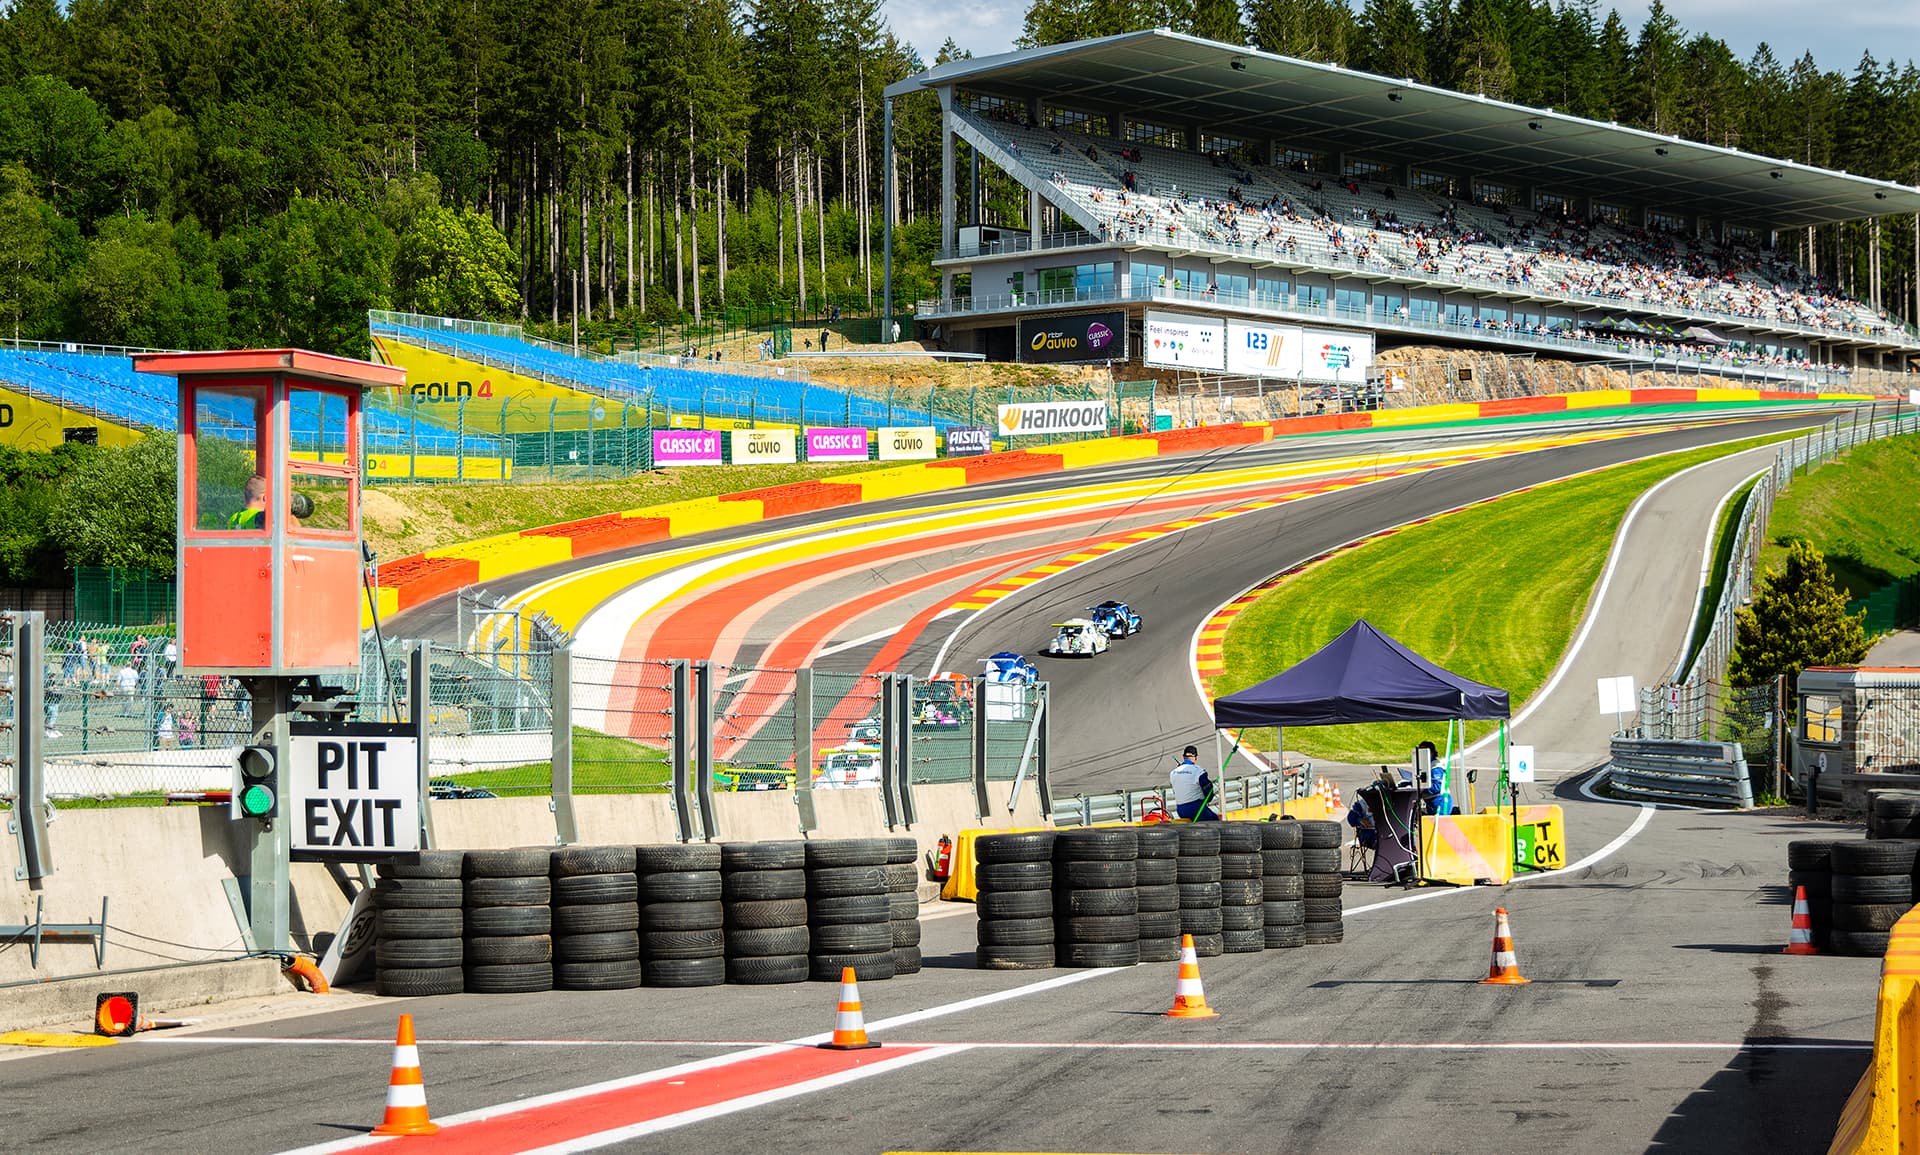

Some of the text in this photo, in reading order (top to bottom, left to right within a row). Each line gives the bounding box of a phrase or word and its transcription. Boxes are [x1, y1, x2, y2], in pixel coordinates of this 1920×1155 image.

[1088, 330, 1108, 340] CLASSIC
[1149, 325, 1189, 337] Feel inspired
[1046, 337, 1078, 350] auvio
[1092, 339, 1101, 347] 21
[1247, 332, 1268, 350] 123
[410, 380, 493, 404] GOLD 4
[660, 438, 715, 453] CLASSIC 21
[748, 441, 781, 454] auvio
[813, 434, 862, 450] CLASSIC 21
[893, 438, 923, 450] auvio
[317, 741, 387, 790] PIT
[304, 798, 402, 847] EXIT
